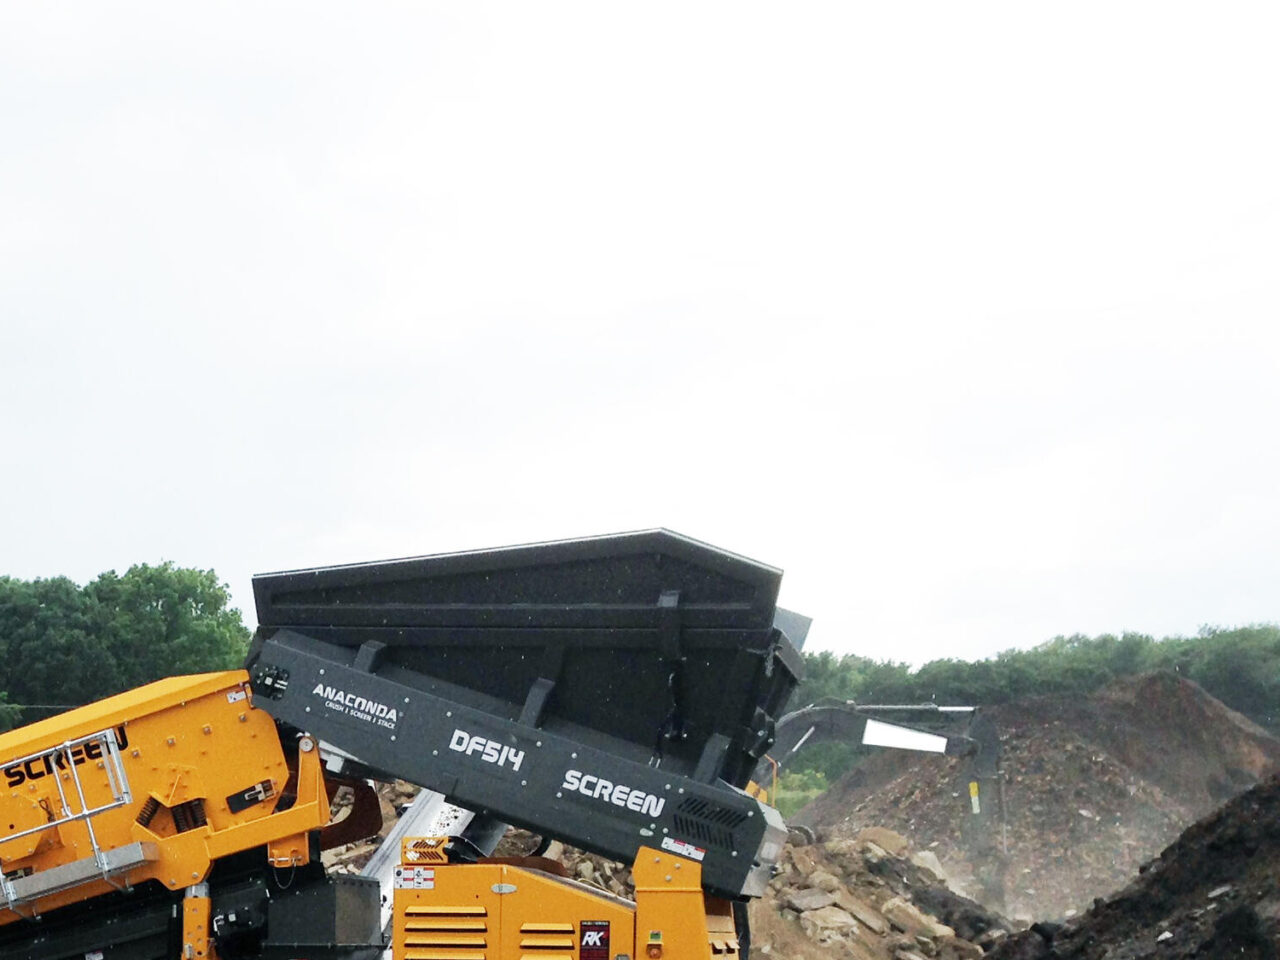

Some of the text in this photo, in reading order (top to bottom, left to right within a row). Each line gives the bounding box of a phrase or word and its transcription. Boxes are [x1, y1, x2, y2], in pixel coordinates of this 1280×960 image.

[312, 683, 397, 722] ANACONDA
[324, 701, 396, 729] CRUSH SCREEN STACK
[449, 728, 525, 772] DF514
[562, 769, 666, 818] SCREEN
[582, 931, 604, 946] RK
